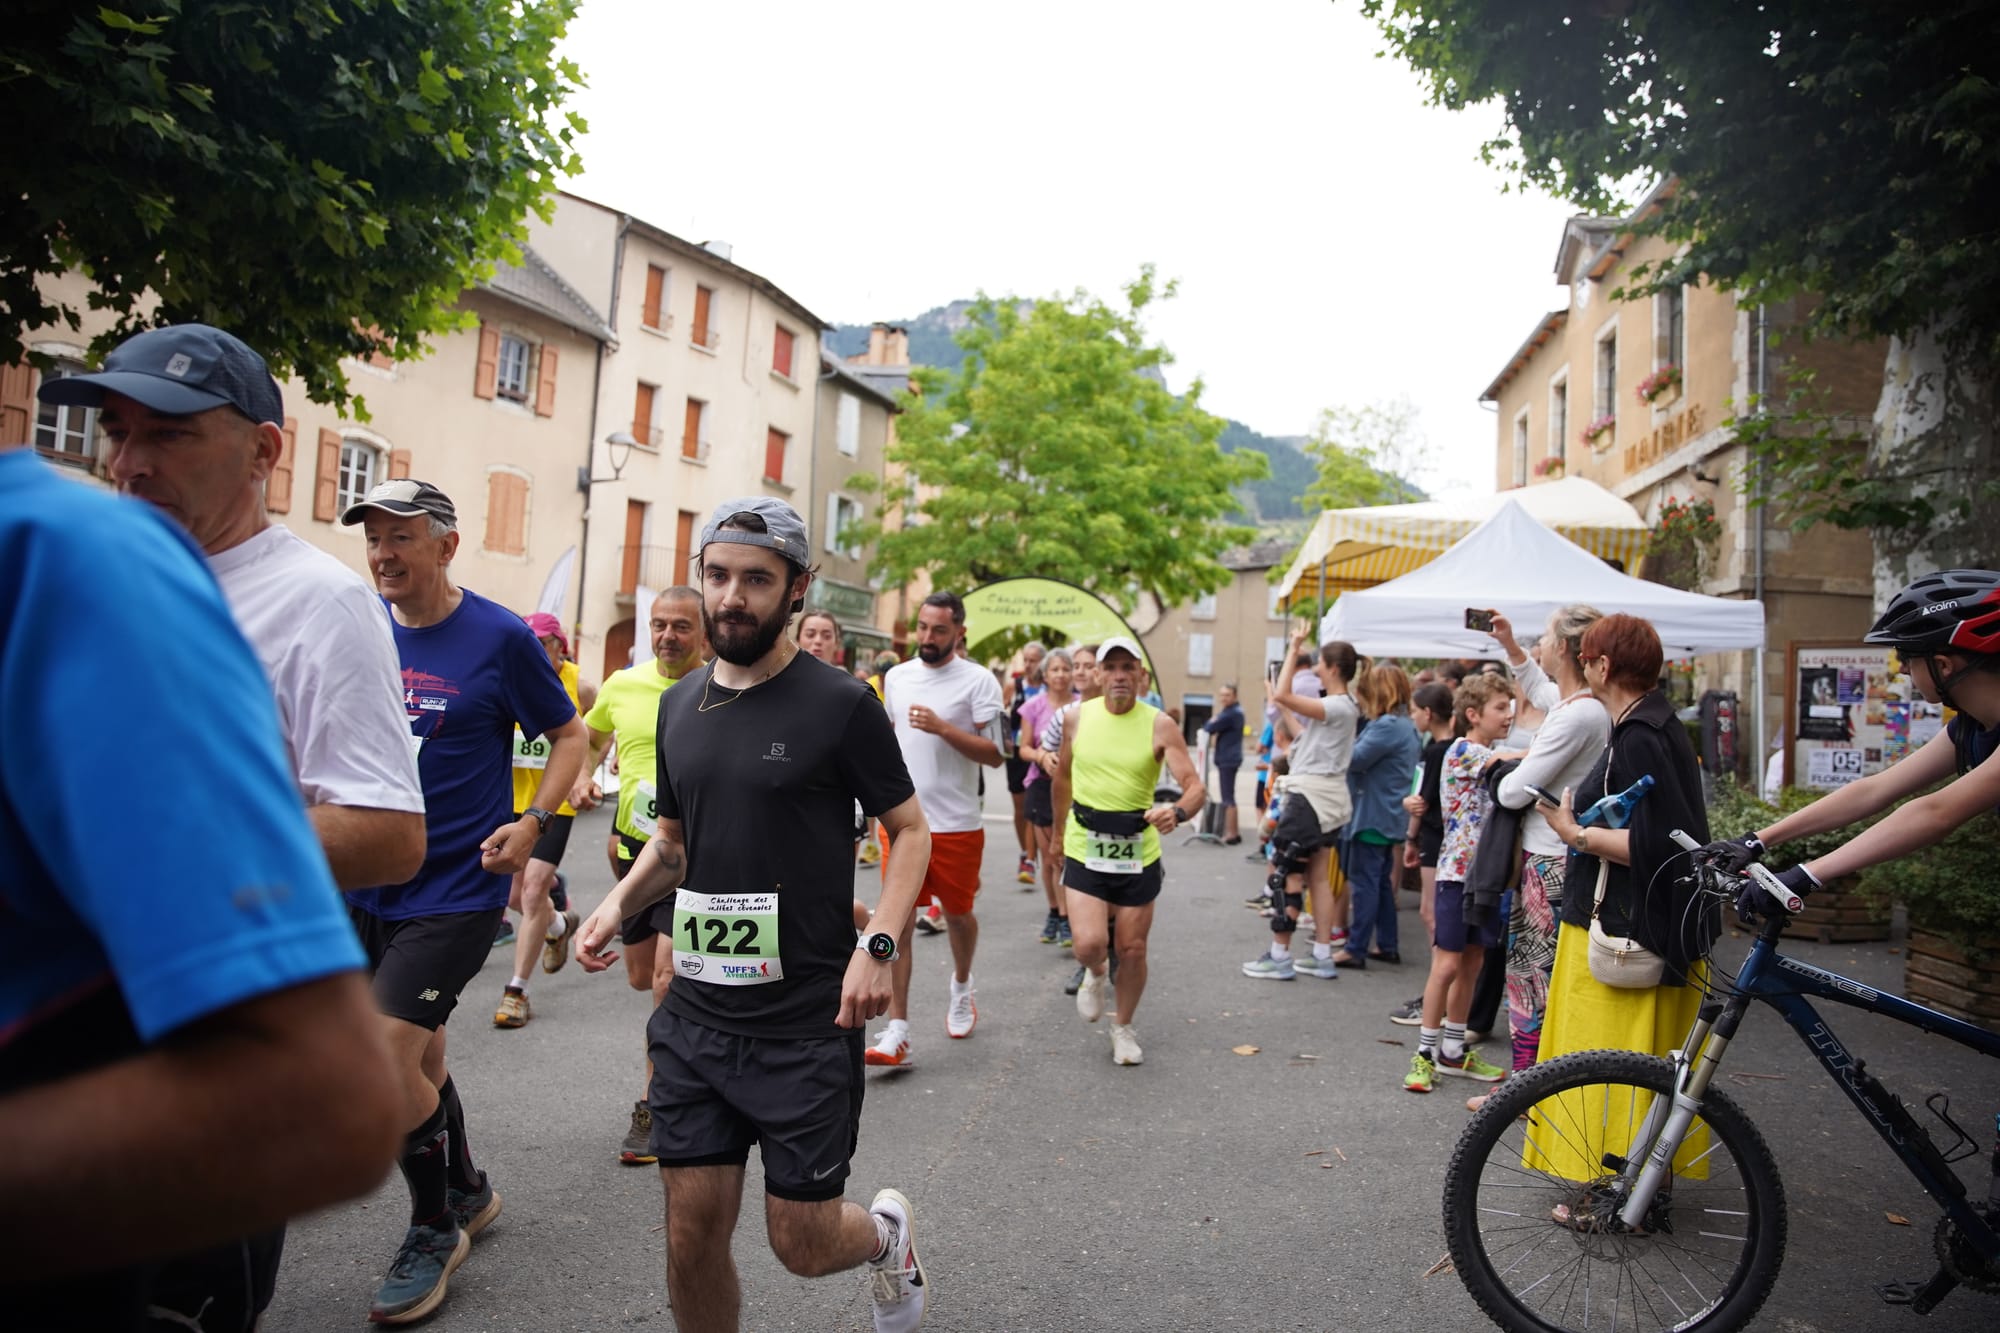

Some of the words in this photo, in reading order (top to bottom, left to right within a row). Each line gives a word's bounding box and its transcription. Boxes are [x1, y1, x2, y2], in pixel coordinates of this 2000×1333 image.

[521, 741, 545, 757] 89
[1834, 752, 1861, 769] 05
[1095, 842, 1135, 860] 124
[711, 897, 749, 906] Challenge
[683, 916, 761, 955] 122
[721, 966, 757, 974] TUFF'S
